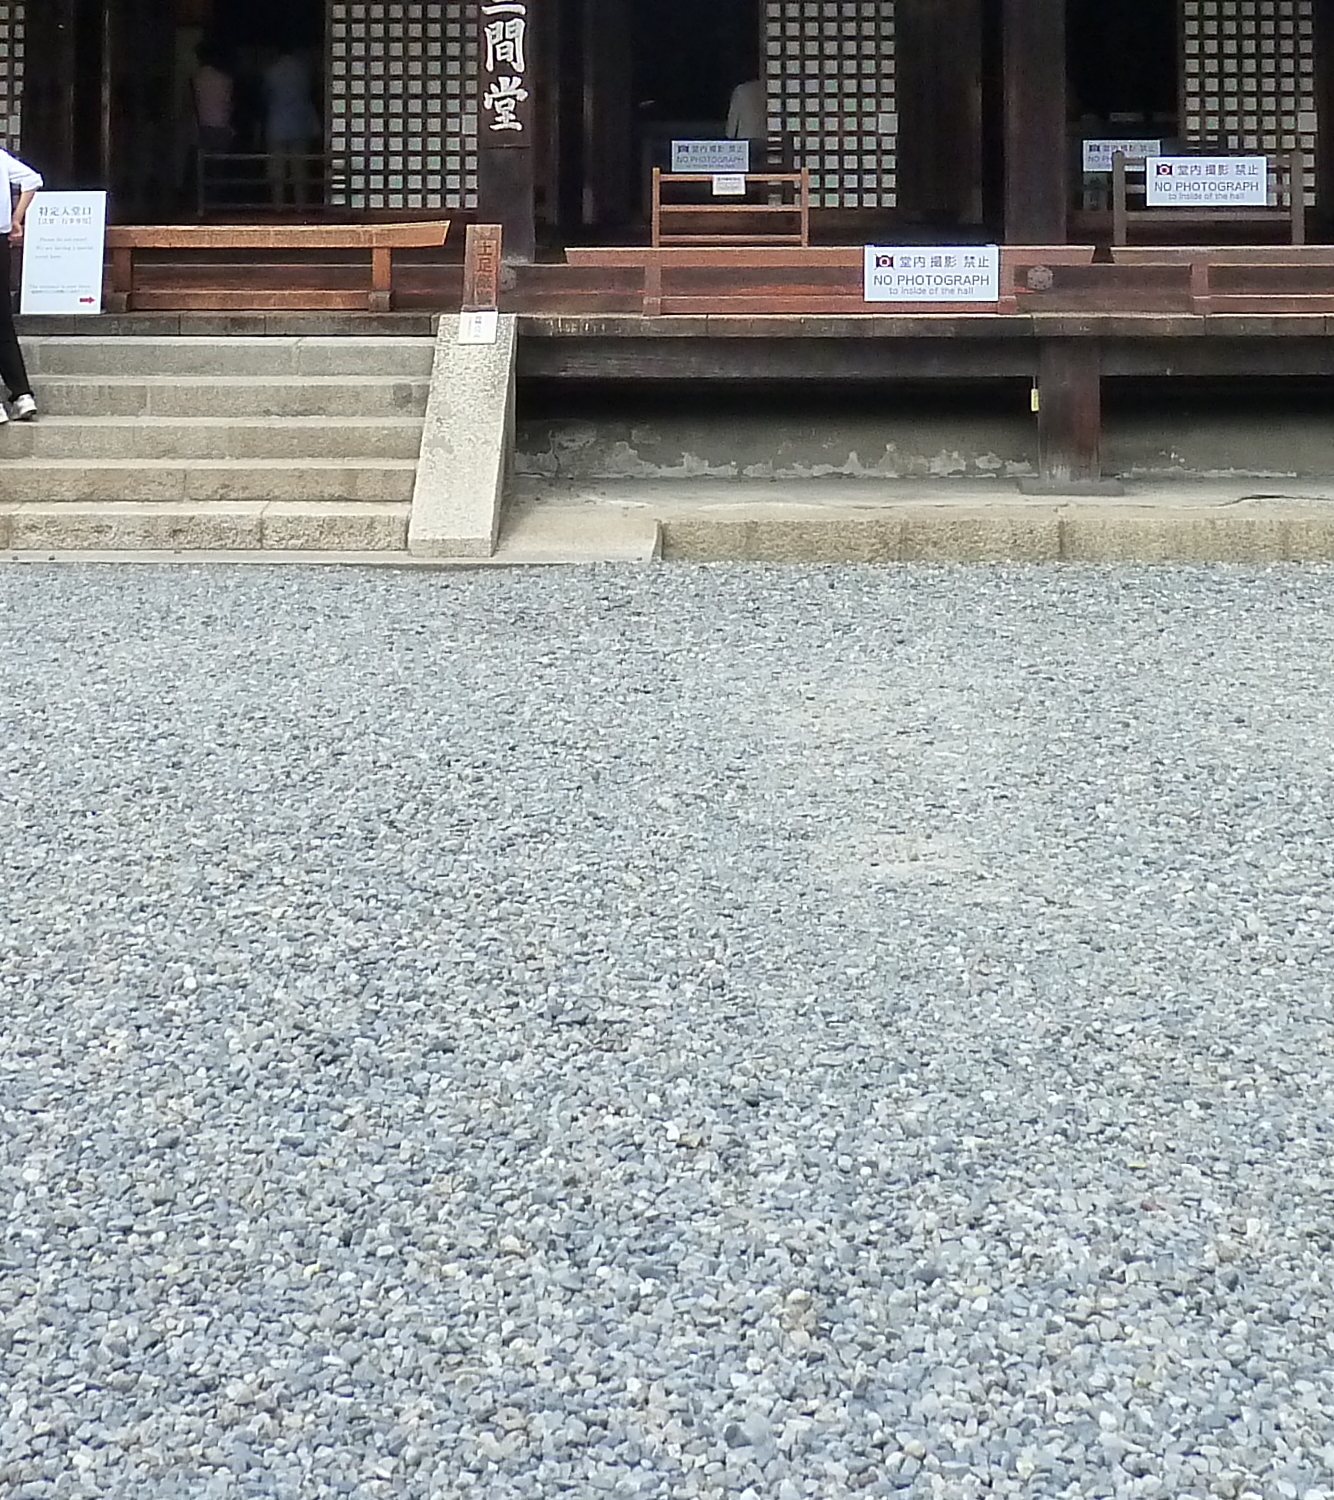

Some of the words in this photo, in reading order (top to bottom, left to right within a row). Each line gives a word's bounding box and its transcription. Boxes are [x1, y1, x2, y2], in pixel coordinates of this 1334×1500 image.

[690, 156, 744, 164] PHOTOGRAPH
[1154, 181, 1172, 192] NO
[1175, 181, 1259, 192] PHOTOGRAPH
[873, 275, 893, 286] NO
[897, 275, 990, 286] PHOTOGRAPH
[889, 287, 899, 295] to
[941, 287, 955, 295] the
